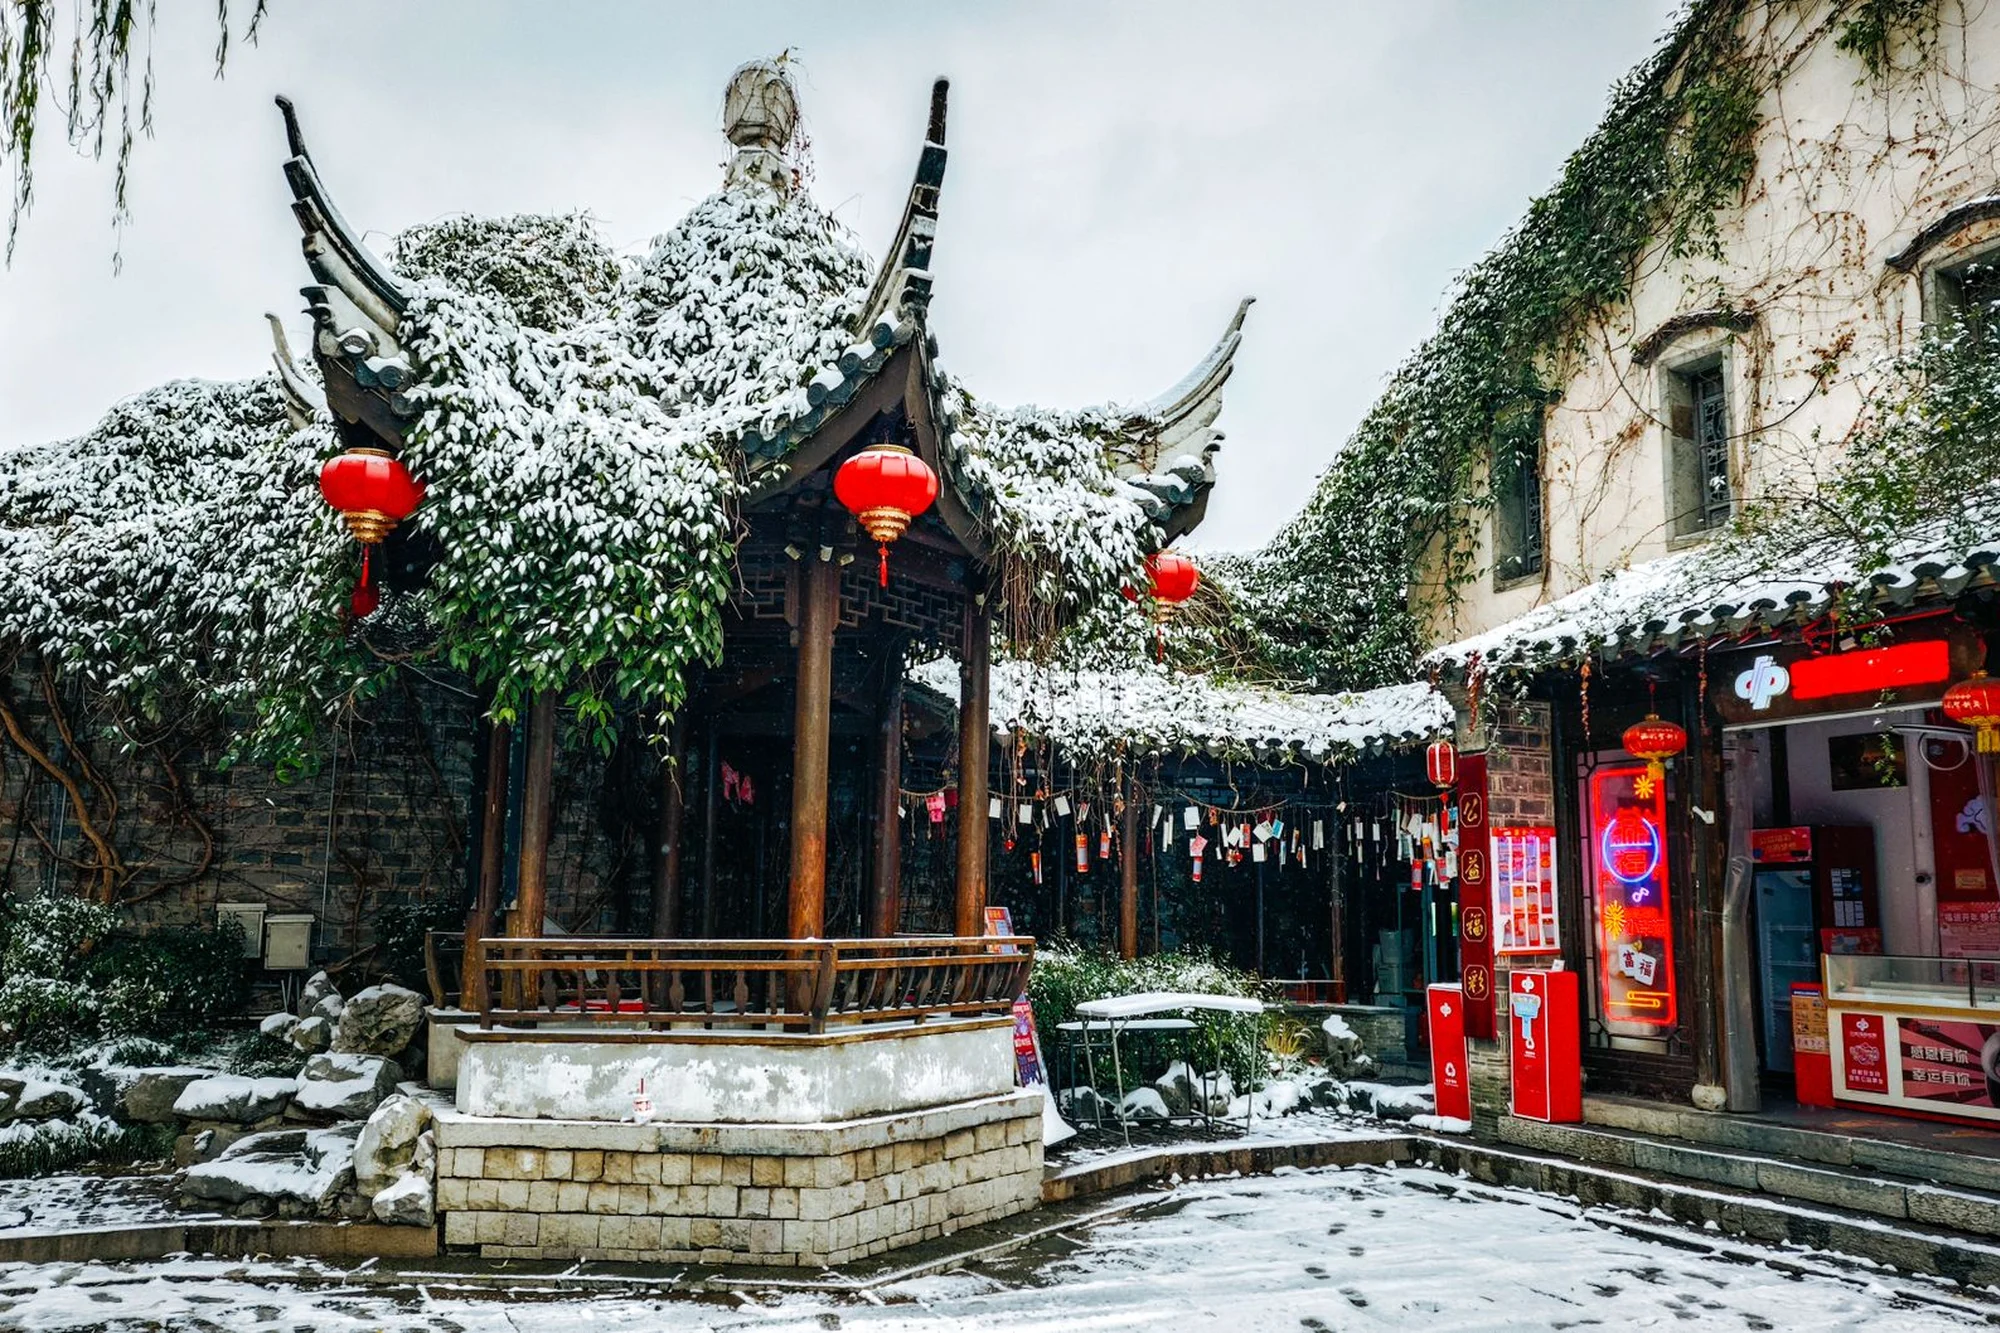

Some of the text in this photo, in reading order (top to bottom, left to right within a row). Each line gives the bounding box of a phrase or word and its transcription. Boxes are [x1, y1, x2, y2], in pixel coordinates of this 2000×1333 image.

[1463, 798, 1485, 994] 公益福彩
[1640, 959, 1653, 977] 福
[1910, 1045, 1969, 1064] 感恩有你
[1912, 1067, 1971, 1086] 幸运有你
